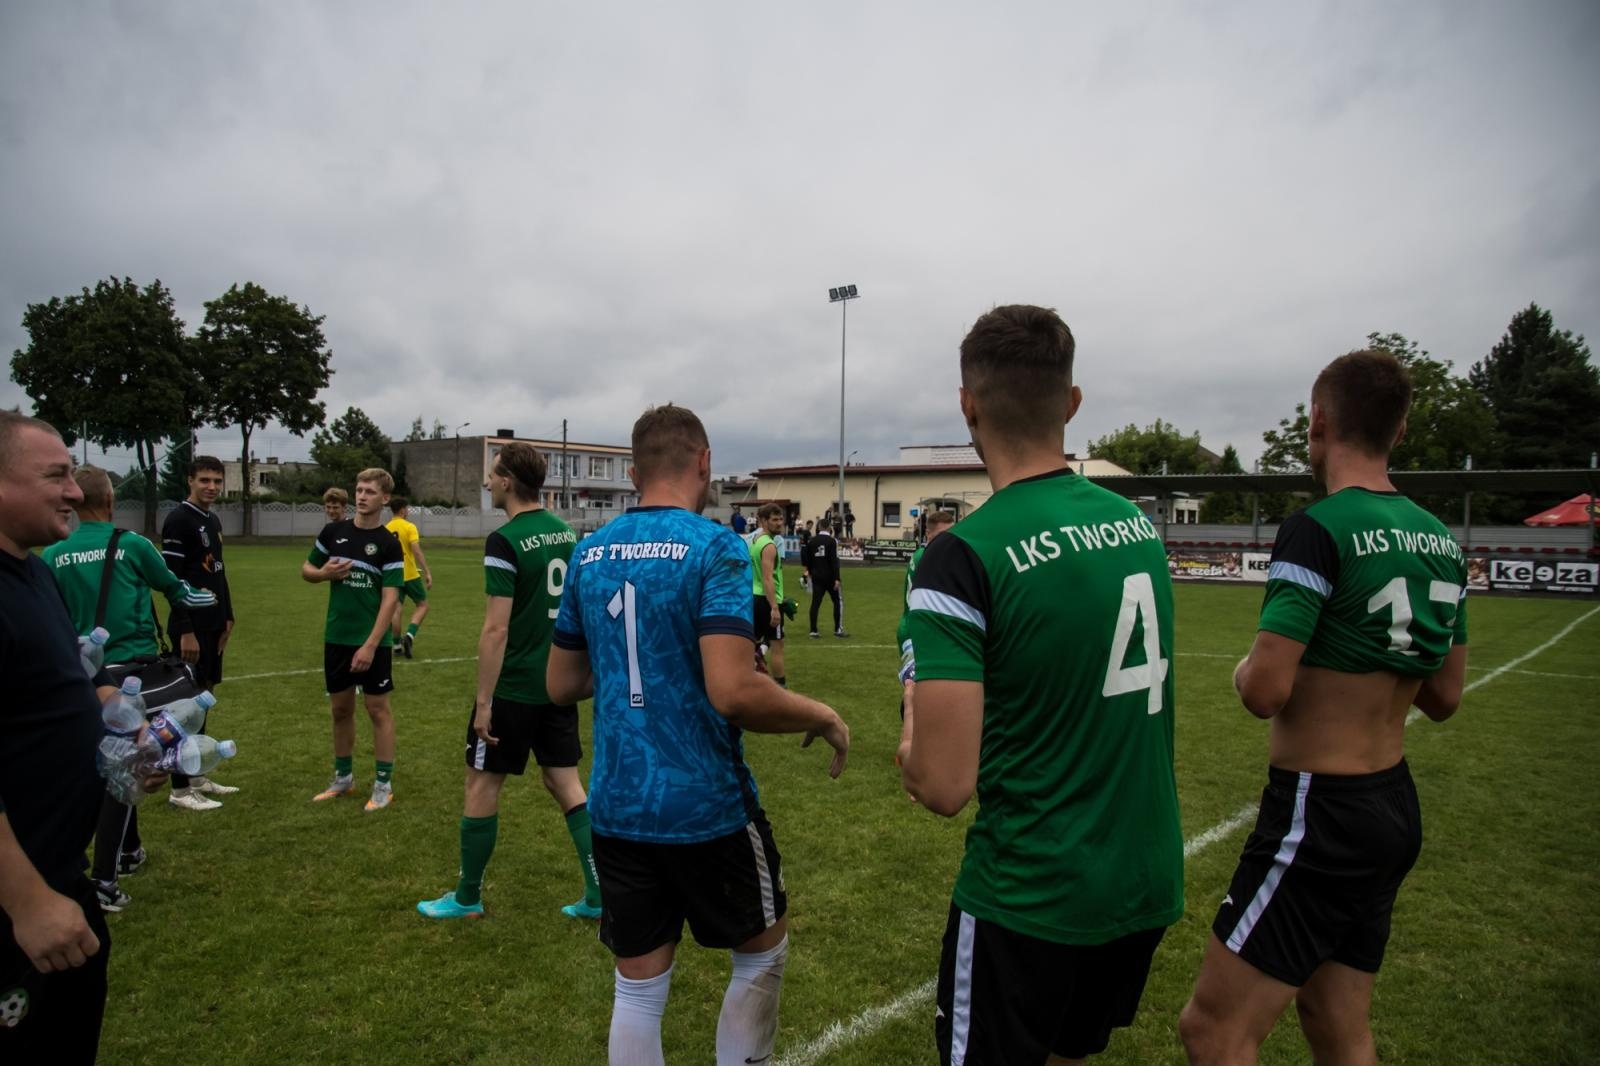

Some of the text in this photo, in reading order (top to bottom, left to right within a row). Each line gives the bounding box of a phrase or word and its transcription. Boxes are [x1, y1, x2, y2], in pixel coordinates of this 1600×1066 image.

[55, 548, 125, 568] LKS TWORKW
[520, 535, 540, 552] LKS
[609, 538, 689, 560] TWORKÓW
[1006, 511, 1161, 573] LKS TWORKÓ
[1352, 529, 1390, 556] LKS
[547, 558, 568, 619] 9
[606, 580, 644, 707] 1
[1102, 572, 1169, 715] 4
